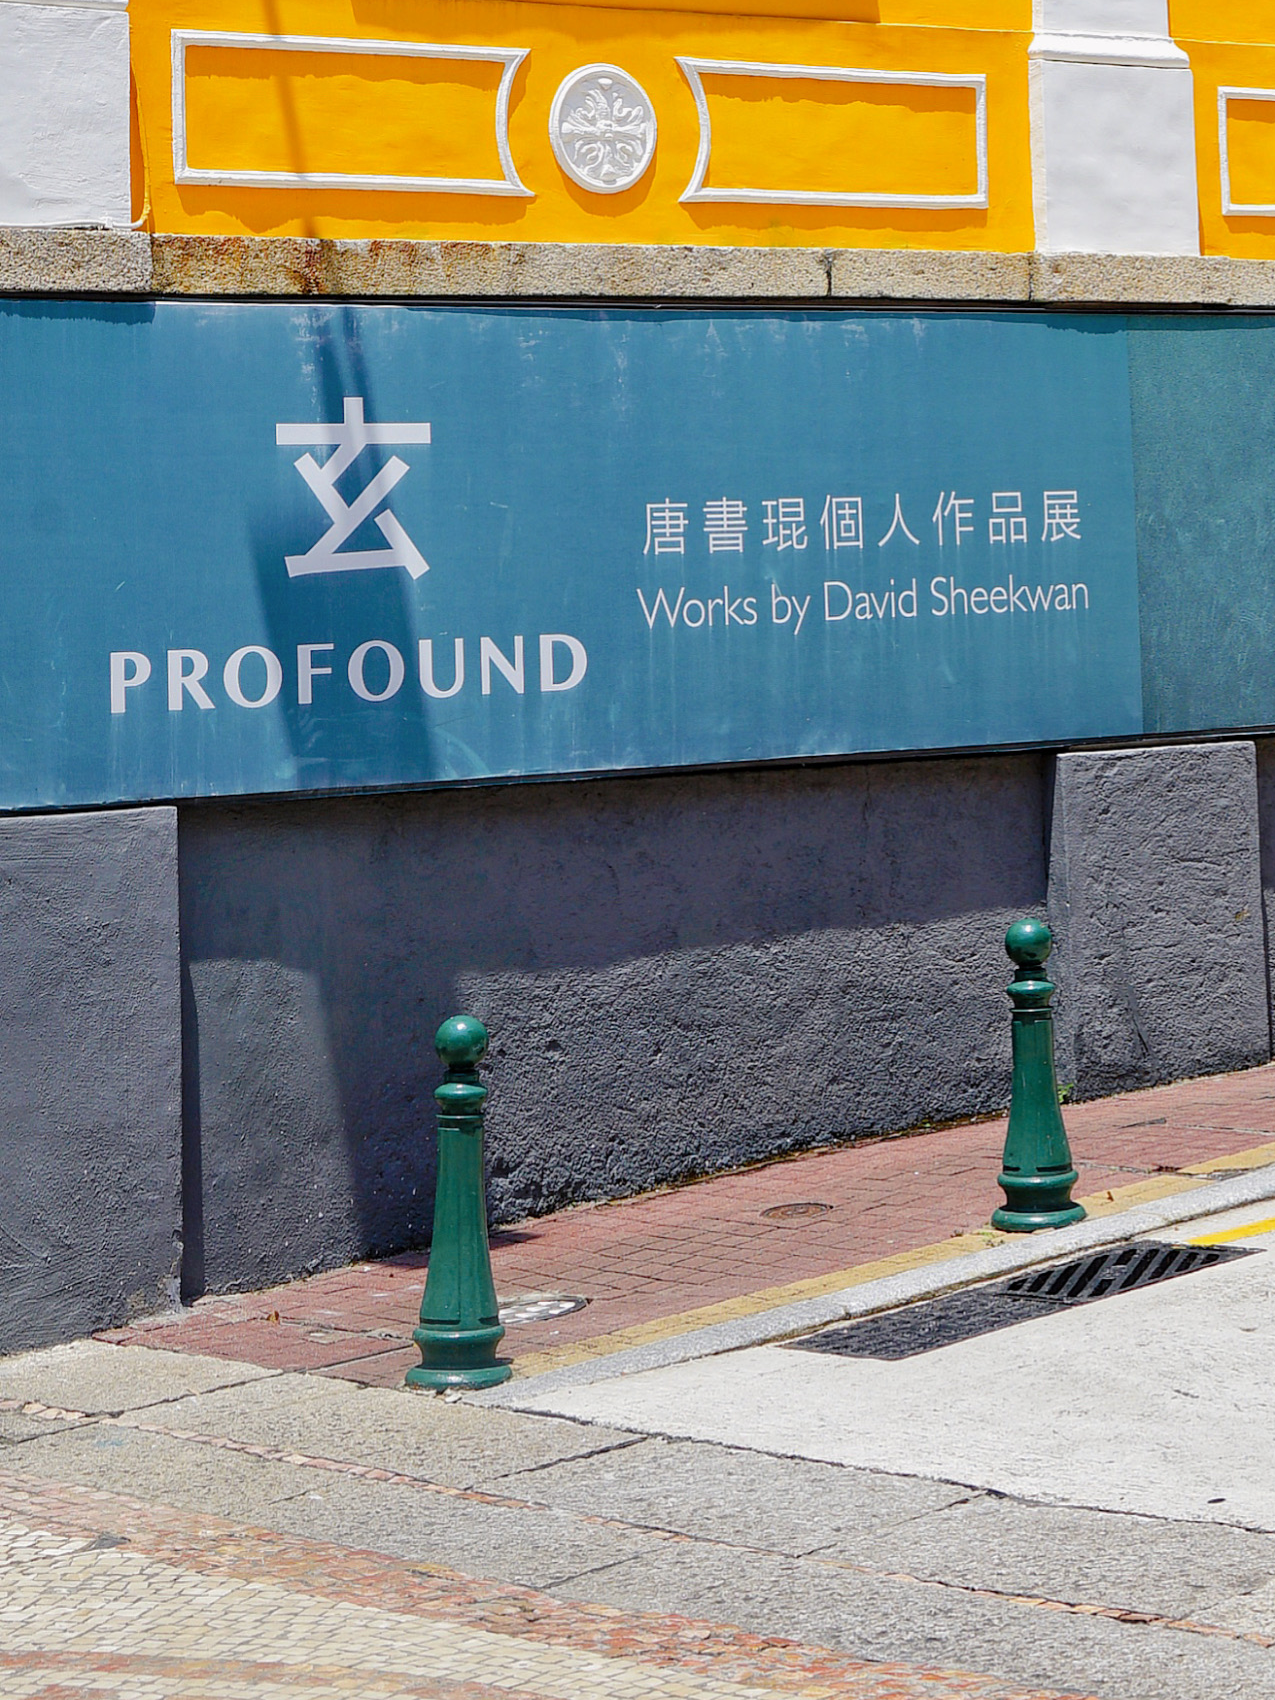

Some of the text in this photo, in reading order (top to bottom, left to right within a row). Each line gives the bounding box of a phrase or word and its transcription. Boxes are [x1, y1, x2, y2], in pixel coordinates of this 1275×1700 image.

[643, 490, 1082, 556] 唐書琨個人作品展
[637, 574, 1089, 636] Works by David Sheekwan
[110, 634, 588, 714] PROFOUND
